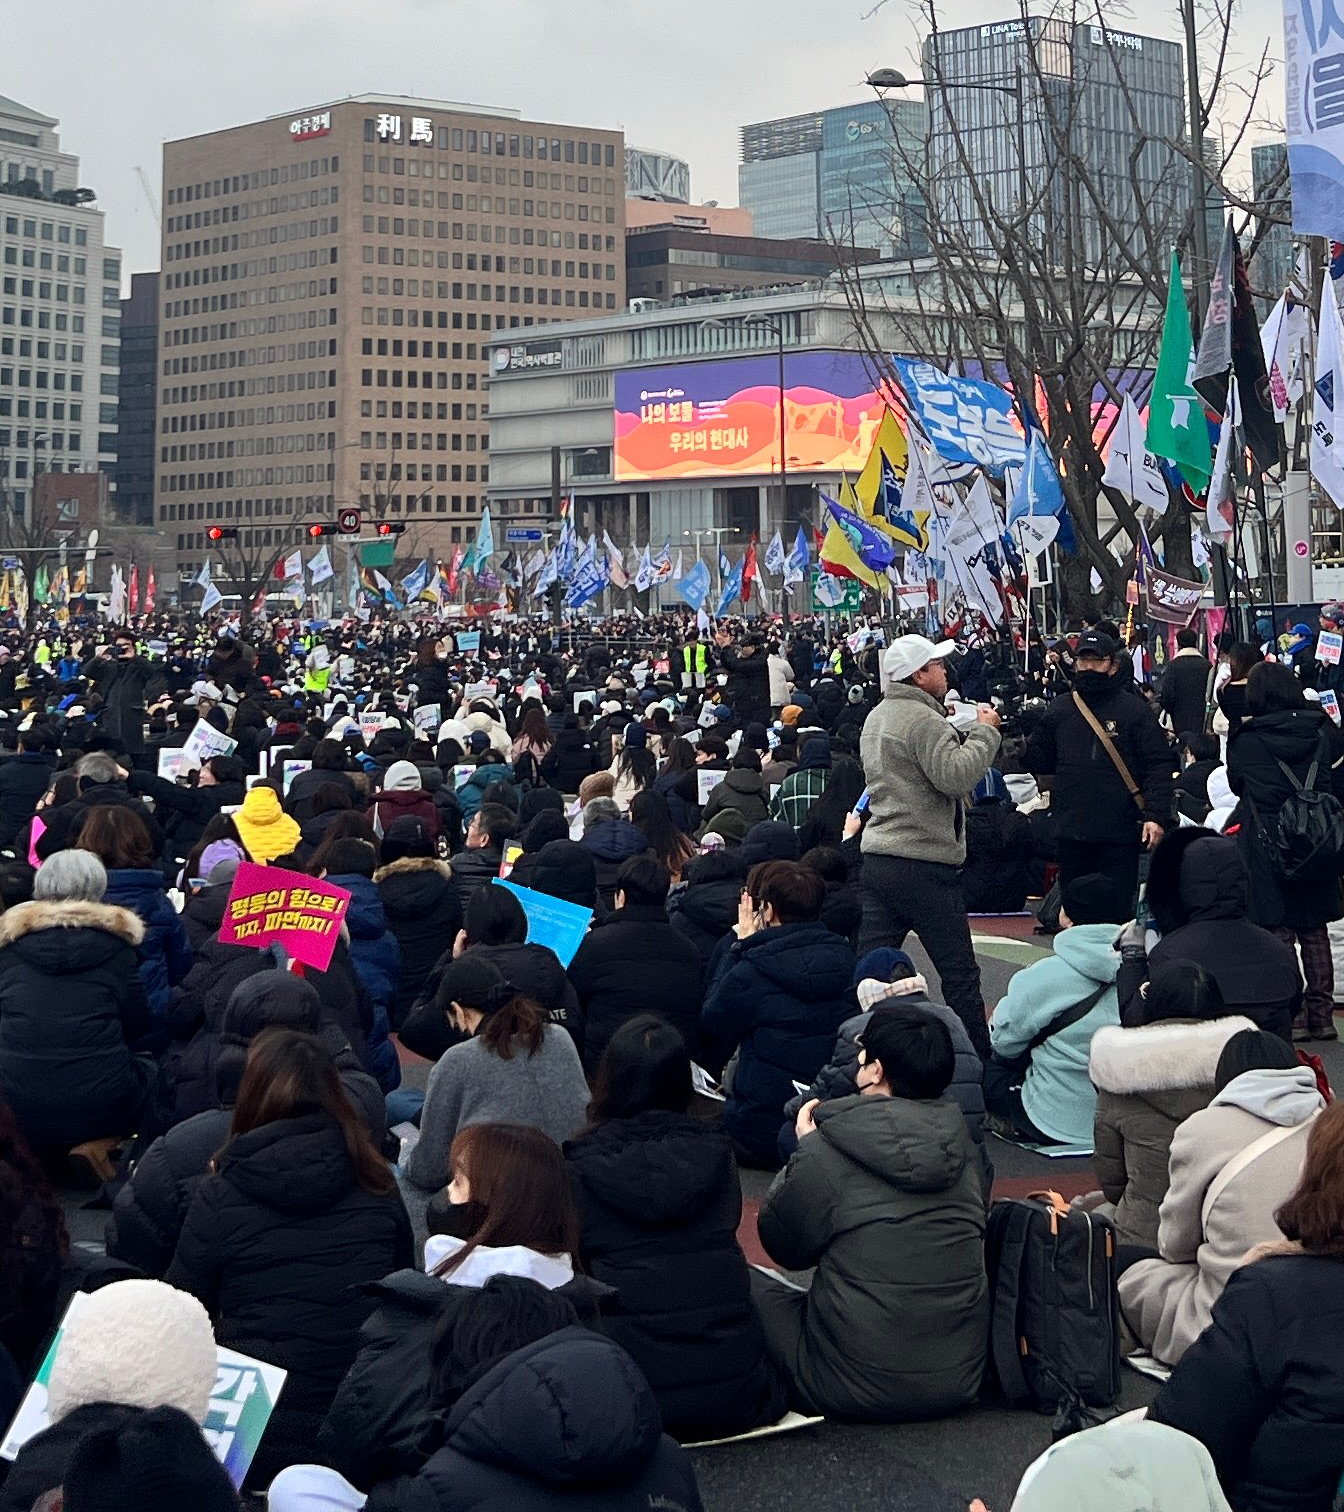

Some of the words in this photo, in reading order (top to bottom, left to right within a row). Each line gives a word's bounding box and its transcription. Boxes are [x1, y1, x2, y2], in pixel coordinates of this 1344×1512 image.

[289, 112, 331, 135] 아주경제
[377, 113, 433, 142] 利馬
[640, 405, 666, 425] 나의
[668, 401, 693, 424] 보물
[669, 432, 708, 453] 우리의
[710, 427, 749, 451] 현대사
[343, 515, 357, 527] 40
[230, 890, 287, 921] 평등의
[289, 888, 345, 915] 힘으로!
[233, 921, 263, 941] 가자,
[263, 911, 335, 938] 파면까지!
